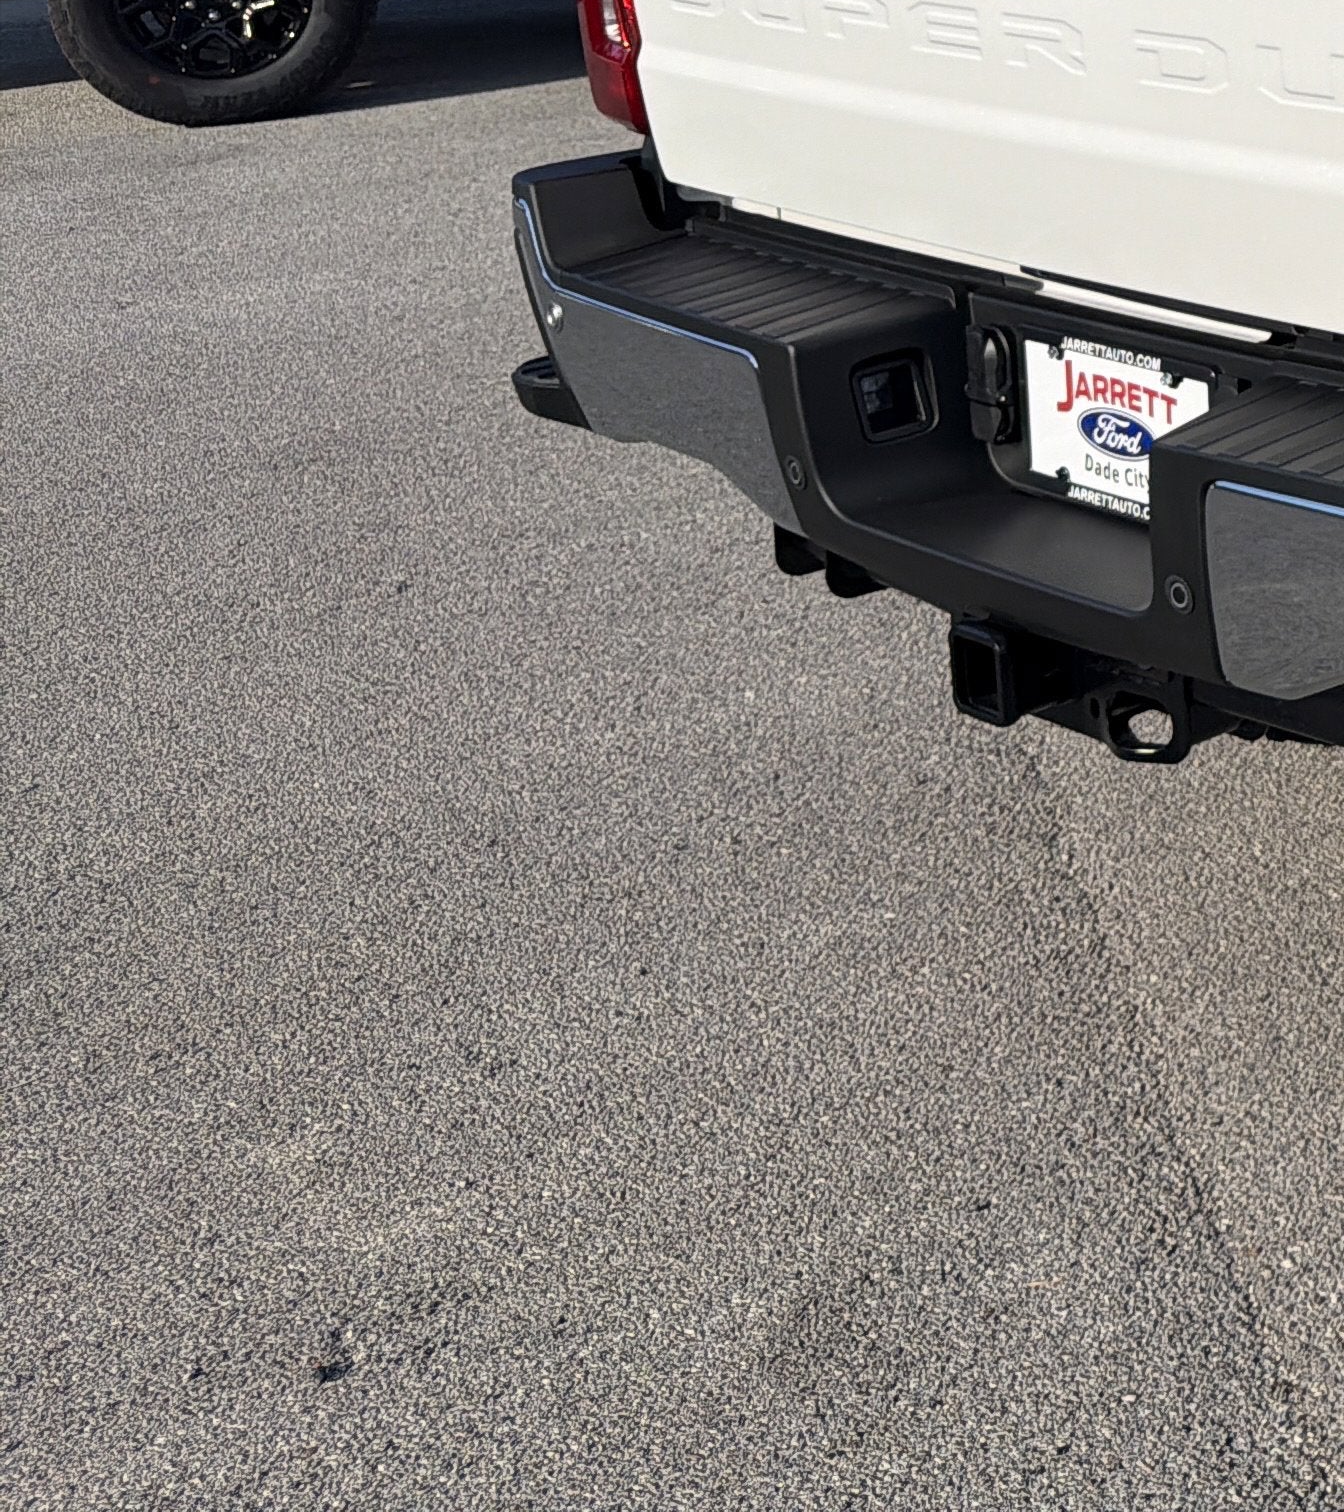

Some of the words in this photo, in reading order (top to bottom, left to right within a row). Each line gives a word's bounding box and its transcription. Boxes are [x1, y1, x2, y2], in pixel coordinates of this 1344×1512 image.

[1060, 336, 1161, 371] JARRETTAUTO.COM
[1057, 360, 1178, 425] JARRETT
[1093, 413, 1143, 455] Ford
[1085, 453, 1120, 483] Dade
[1068, 485, 1150, 520] JARRETTAUTO.C
